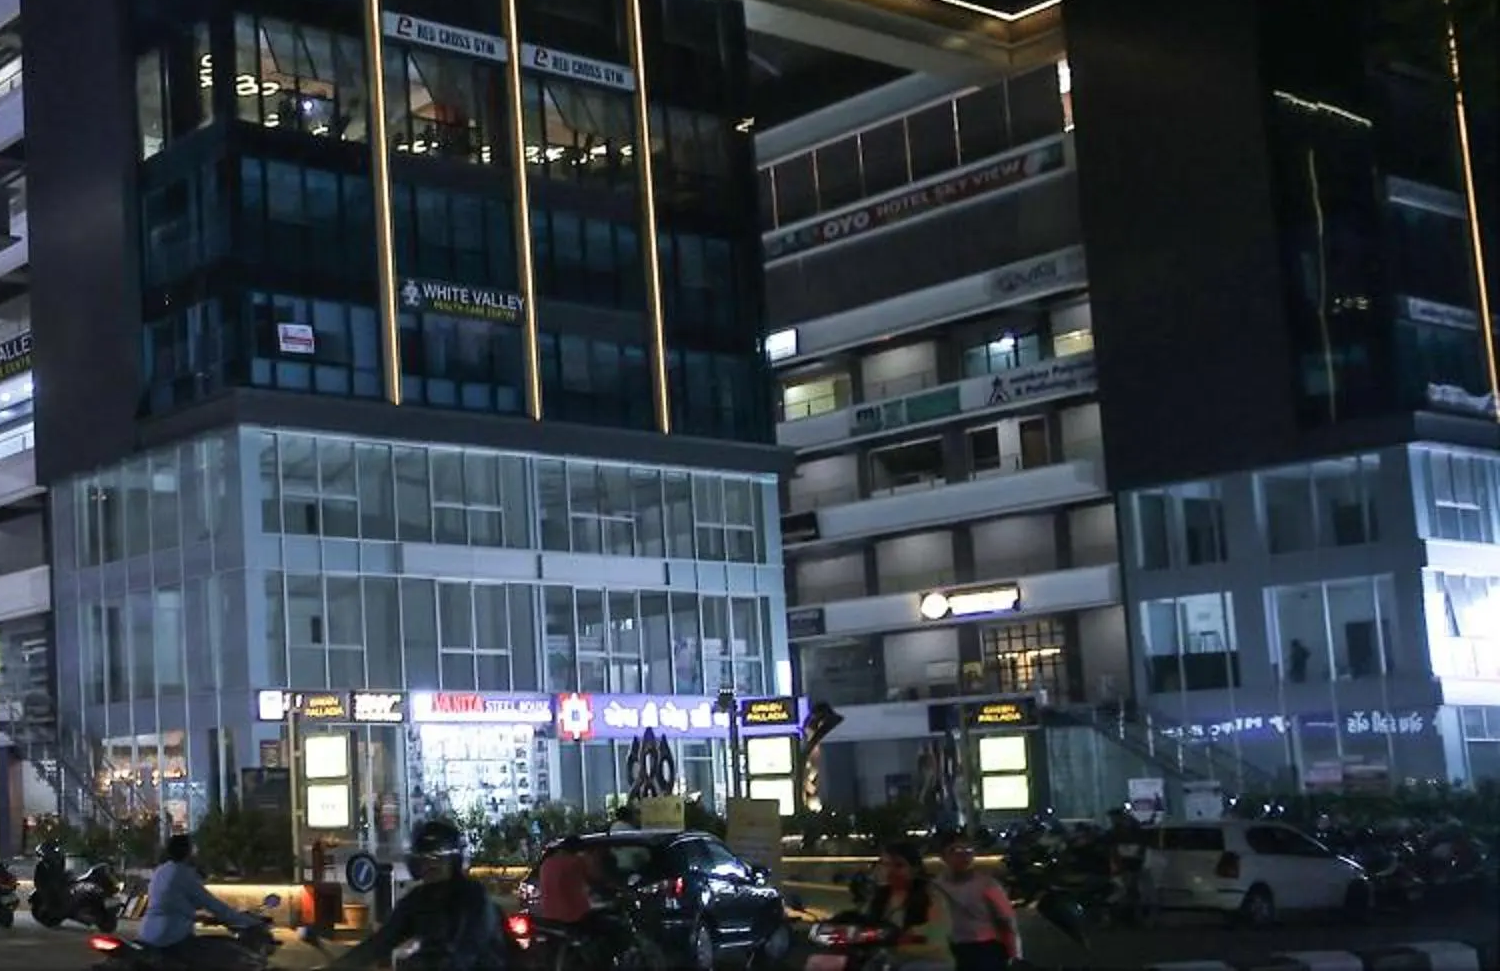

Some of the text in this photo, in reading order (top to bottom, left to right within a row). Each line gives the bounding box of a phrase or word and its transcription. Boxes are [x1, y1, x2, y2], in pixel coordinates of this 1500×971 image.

[439, 29, 471, 50] CROSS
[474, 37, 497, 55] GYM
[572, 60, 602, 79] CROSS
[604, 67, 625, 84] GYM
[822, 211, 870, 239] OYO
[876, 192, 928, 217] HOTEL
[972, 159, 1020, 186] VIEW
[422, 283, 525, 312] WHITE VALLEY
